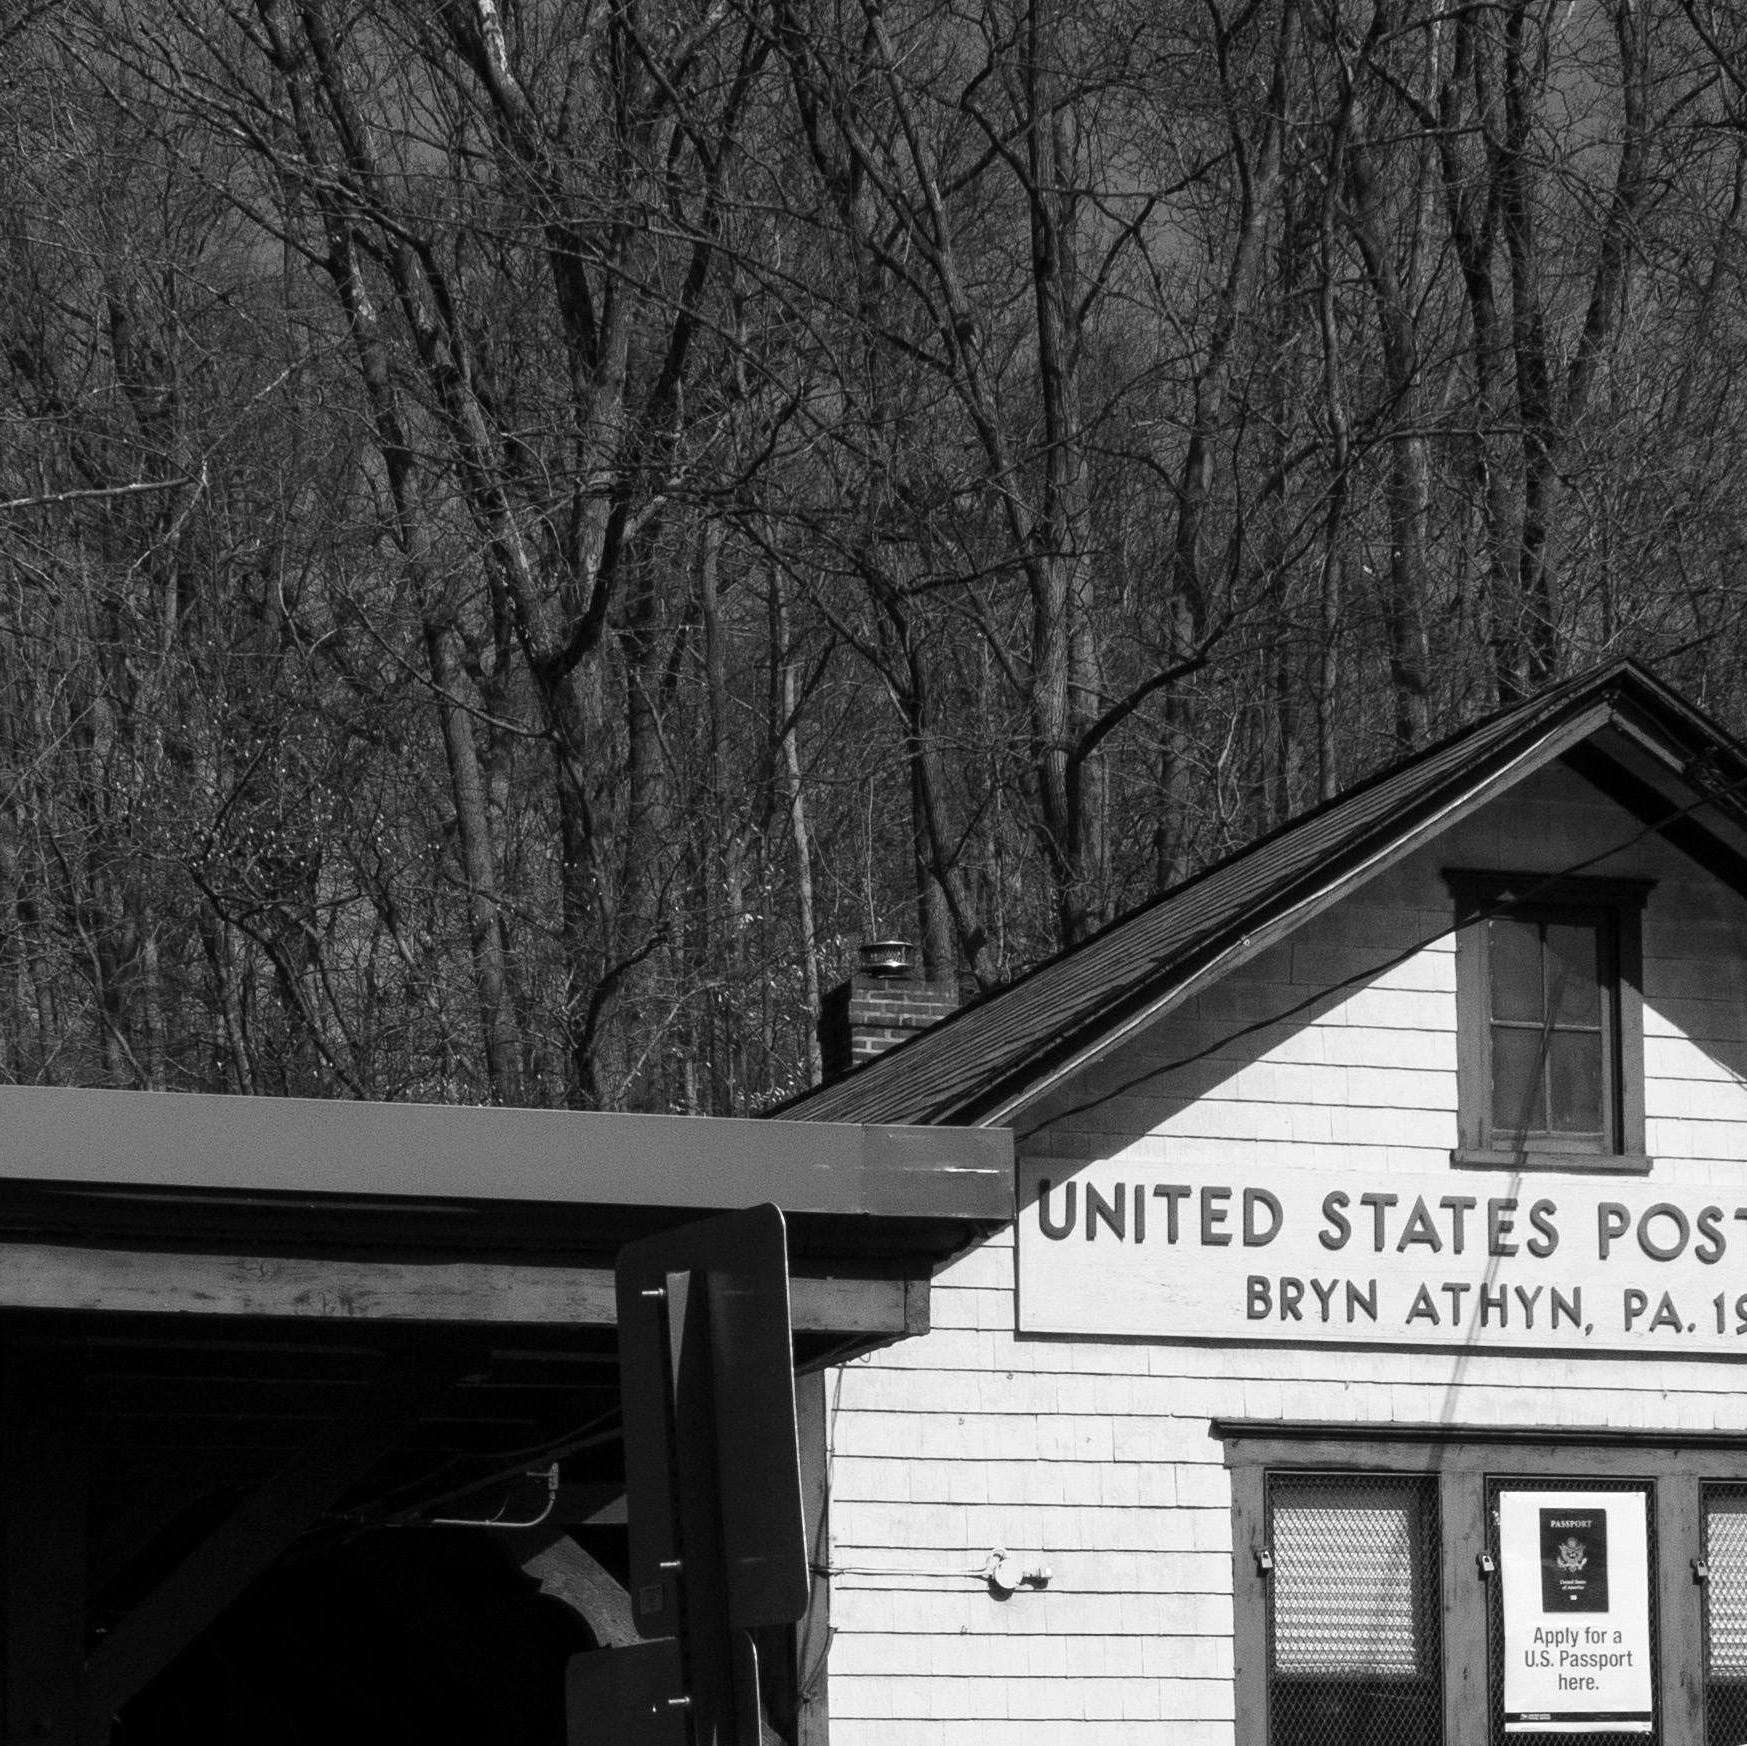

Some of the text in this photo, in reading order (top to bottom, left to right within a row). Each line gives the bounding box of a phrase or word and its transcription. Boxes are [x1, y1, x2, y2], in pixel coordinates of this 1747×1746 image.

[1038, 1178, 1284, 1248] UNITED
[1318, 1190, 1559, 1259] STATES
[1246, 1274, 1379, 1324] BRYN
[1404, 1281, 1595, 1338] ATHYN,
[1550, 1520, 1593, 1528] PASSPORT
[1533, 1626, 1623, 1648] Apply for a
[1524, 1649, 1634, 1671] U.S. Passport
[1558, 1673, 1600, 1691] here.
